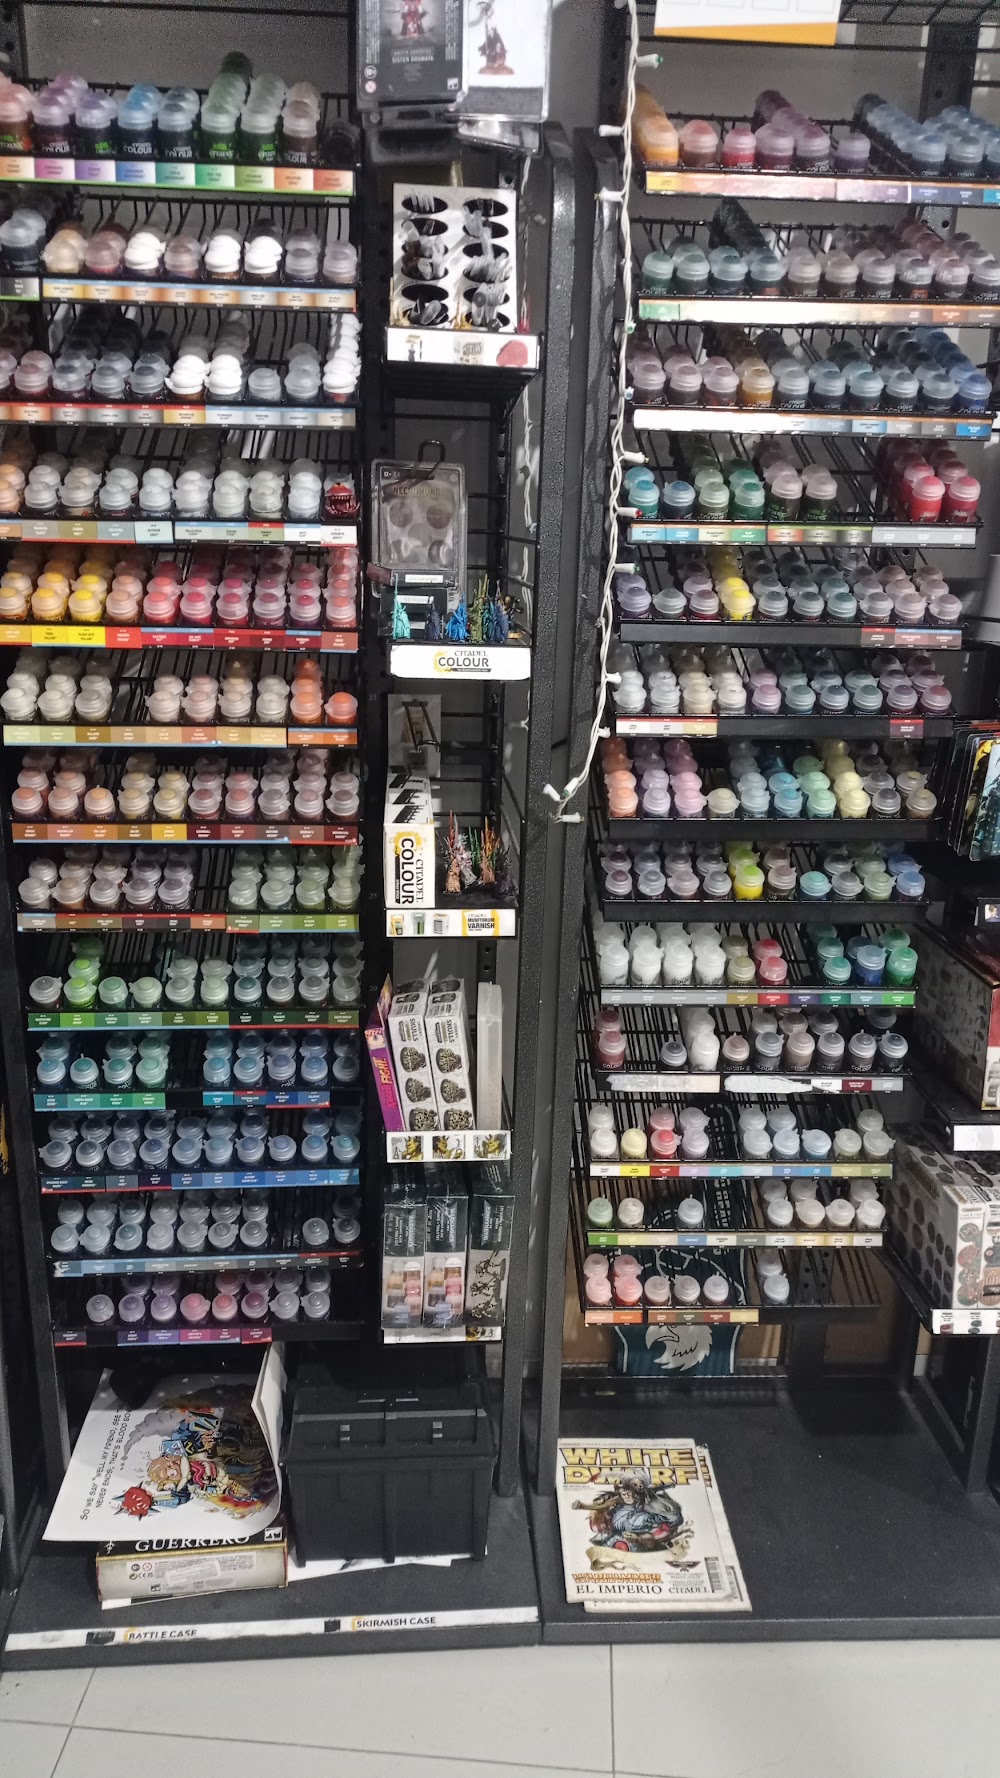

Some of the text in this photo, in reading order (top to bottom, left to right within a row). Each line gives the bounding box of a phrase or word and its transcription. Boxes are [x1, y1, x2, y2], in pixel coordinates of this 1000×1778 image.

[438, 657, 489, 667] COLOUR
[401, 838, 414, 904] COLOUR
[416, 858, 424, 903] CITADEL
[410, 1018, 418, 1042] SKULLS
[446, 1019, 454, 1043] SKULLS
[448, 1208, 456, 1242] WARHAMMER
[482, 1206, 491, 1241] WARHAMMER
[112, 1414, 122, 1426] SEE
[102, 1450, 109, 1461] MY
[559, 1447, 696, 1467] WHITE
[96, 1487, 106, 1508] NEVER
[108, 1444, 120, 1466] THAT'S
[116, 1422, 128, 1444] BLOOD
[562, 1466, 699, 1486] DWRF
[89, 1482, 98, 1496] SAY
[86, 1497, 94, 1508] WE
[80, 1508, 90, 1520] SO
[572, 1572, 664, 1584] WARHAMMER
[576, 1585, 662, 1594] EL IMPERIO
[668, 1586, 710, 1594] CITADEL
[356, 1616, 436, 1628] SKIRMISH CASE
[169, 1630, 197, 1638] CASE
